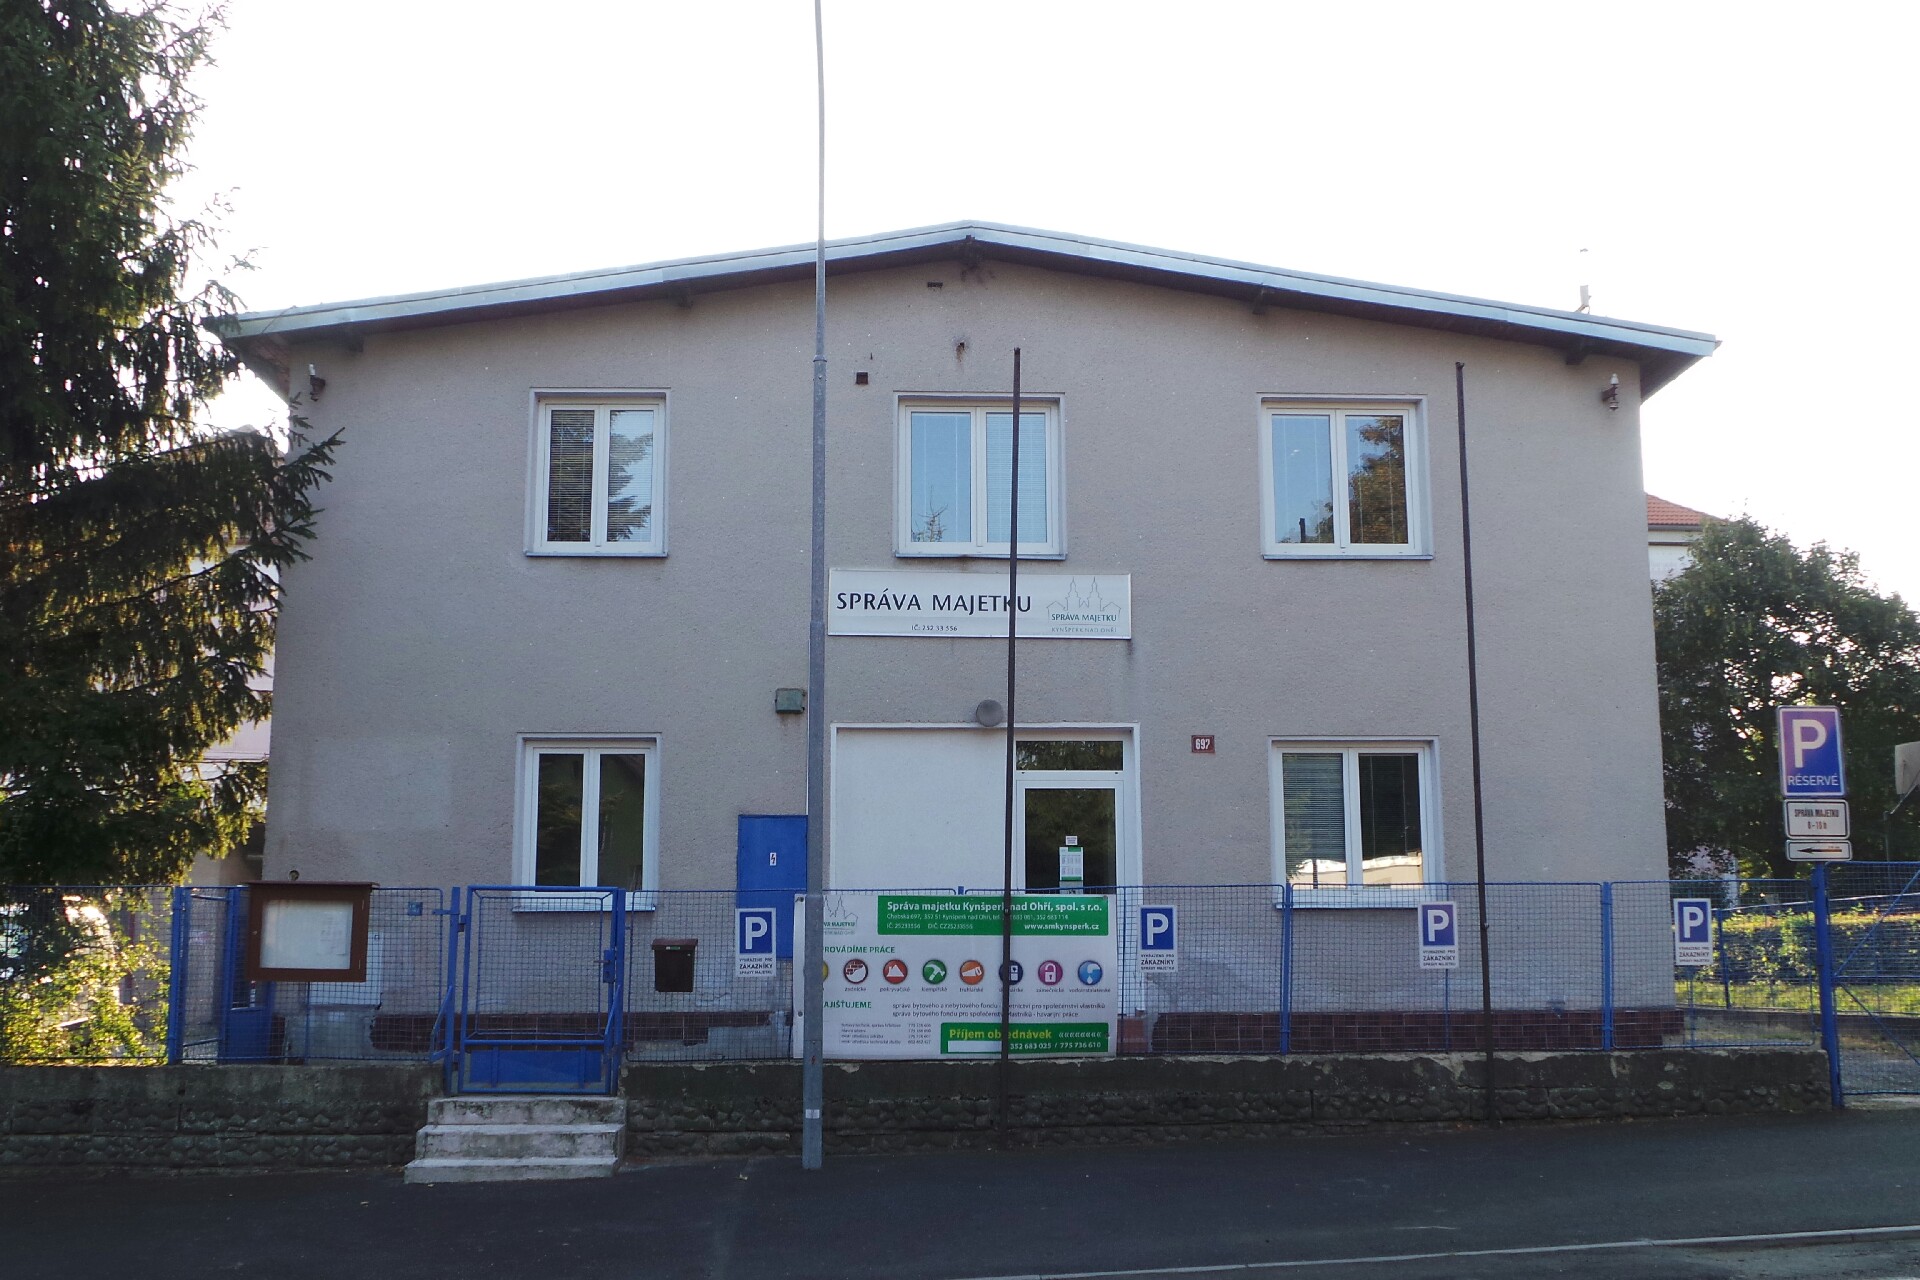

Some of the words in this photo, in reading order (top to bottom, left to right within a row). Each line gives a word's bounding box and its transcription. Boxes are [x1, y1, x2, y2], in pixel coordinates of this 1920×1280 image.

[836, 588, 922, 611] SPRÁVA
[1051, 611, 1080, 621] SPRÁVA
[1082, 614, 1117, 623] MAJETKU
[1195, 738, 1210, 750] 697
[1792, 719, 1828, 769] P
[1787, 772, 1839, 786] RÉSERVÉ
[887, 901, 920, 912] Správa
[922, 901, 961, 913] majetku
[1010, 901, 1028, 911] nad
[1029, 901, 1054, 912] Ohří,
[1055, 902, 1079, 912] spol.
[1024, 922, 1100, 931] www.smkynsperk.cz
[1427, 909, 1450, 942] P
[1683, 906, 1704, 938] P
[745, 916, 768, 950] P
[1146, 912, 1169, 946] P
[824, 944, 868, 954] ROVÁDÍME
[869, 944, 896, 954] PRÁCE
[739, 961, 773, 970] ZÁKAZNÍKY
[1140, 957, 1175, 966] ZÁKAZNÍKY
[823, 1000, 872, 1009] AJIŠŤUJEME
[949, 1028, 985, 1041] Příjem
